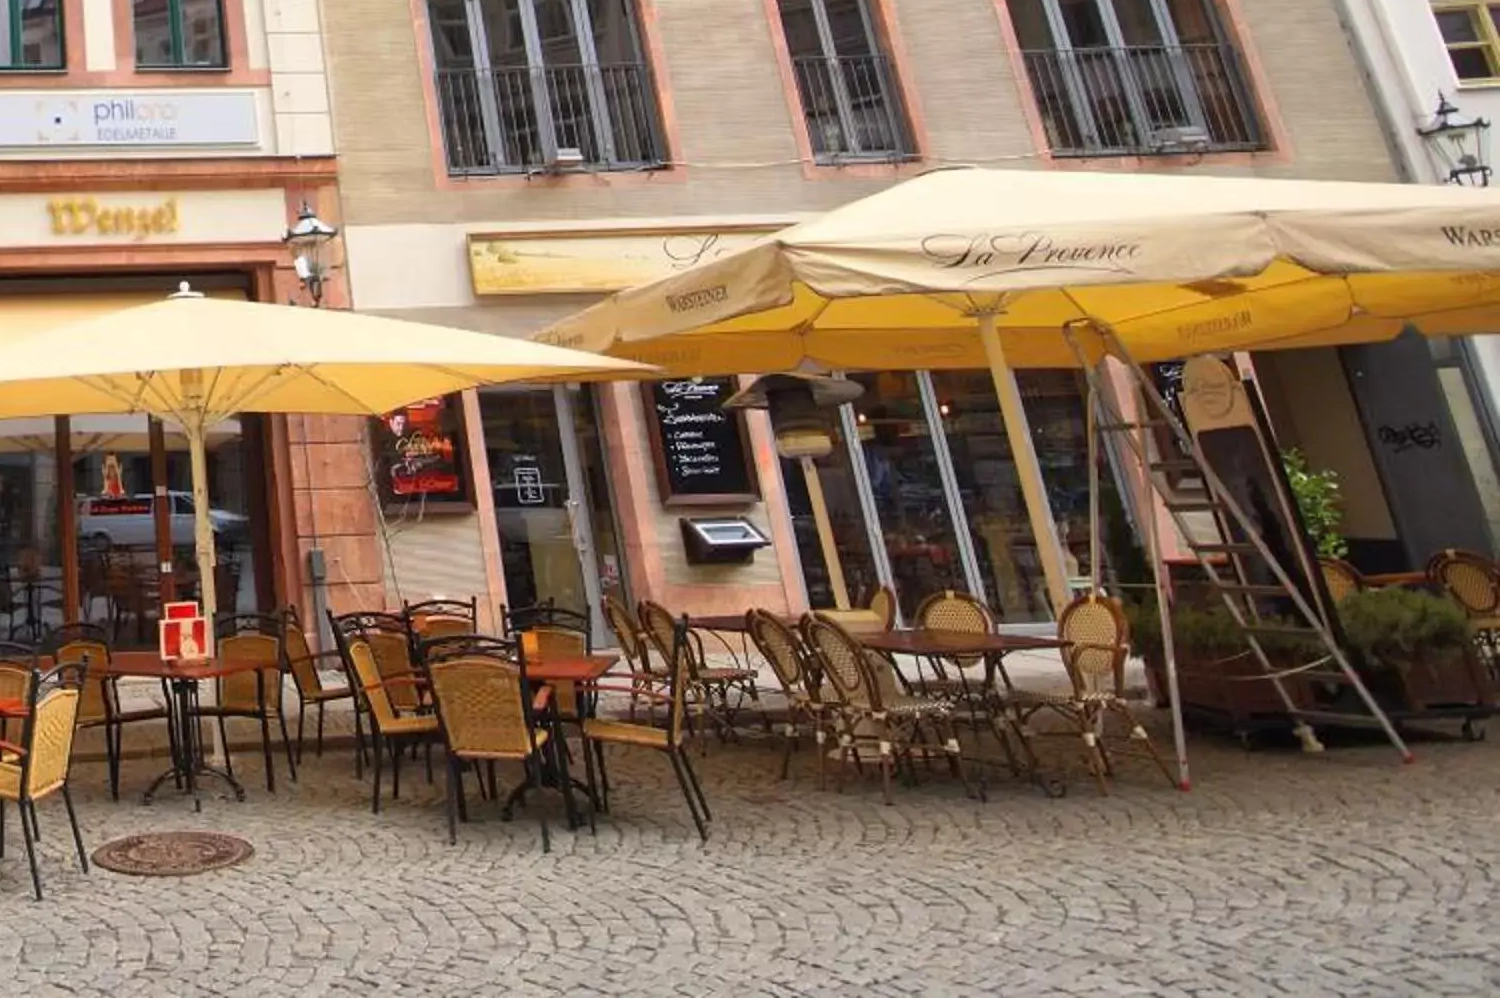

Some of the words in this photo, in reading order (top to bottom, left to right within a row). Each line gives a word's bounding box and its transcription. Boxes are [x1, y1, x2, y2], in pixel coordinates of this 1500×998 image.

[46, 195, 181, 241] Wenzel
[921, 233, 993, 269] La
[990, 231, 1143, 265] Provence
